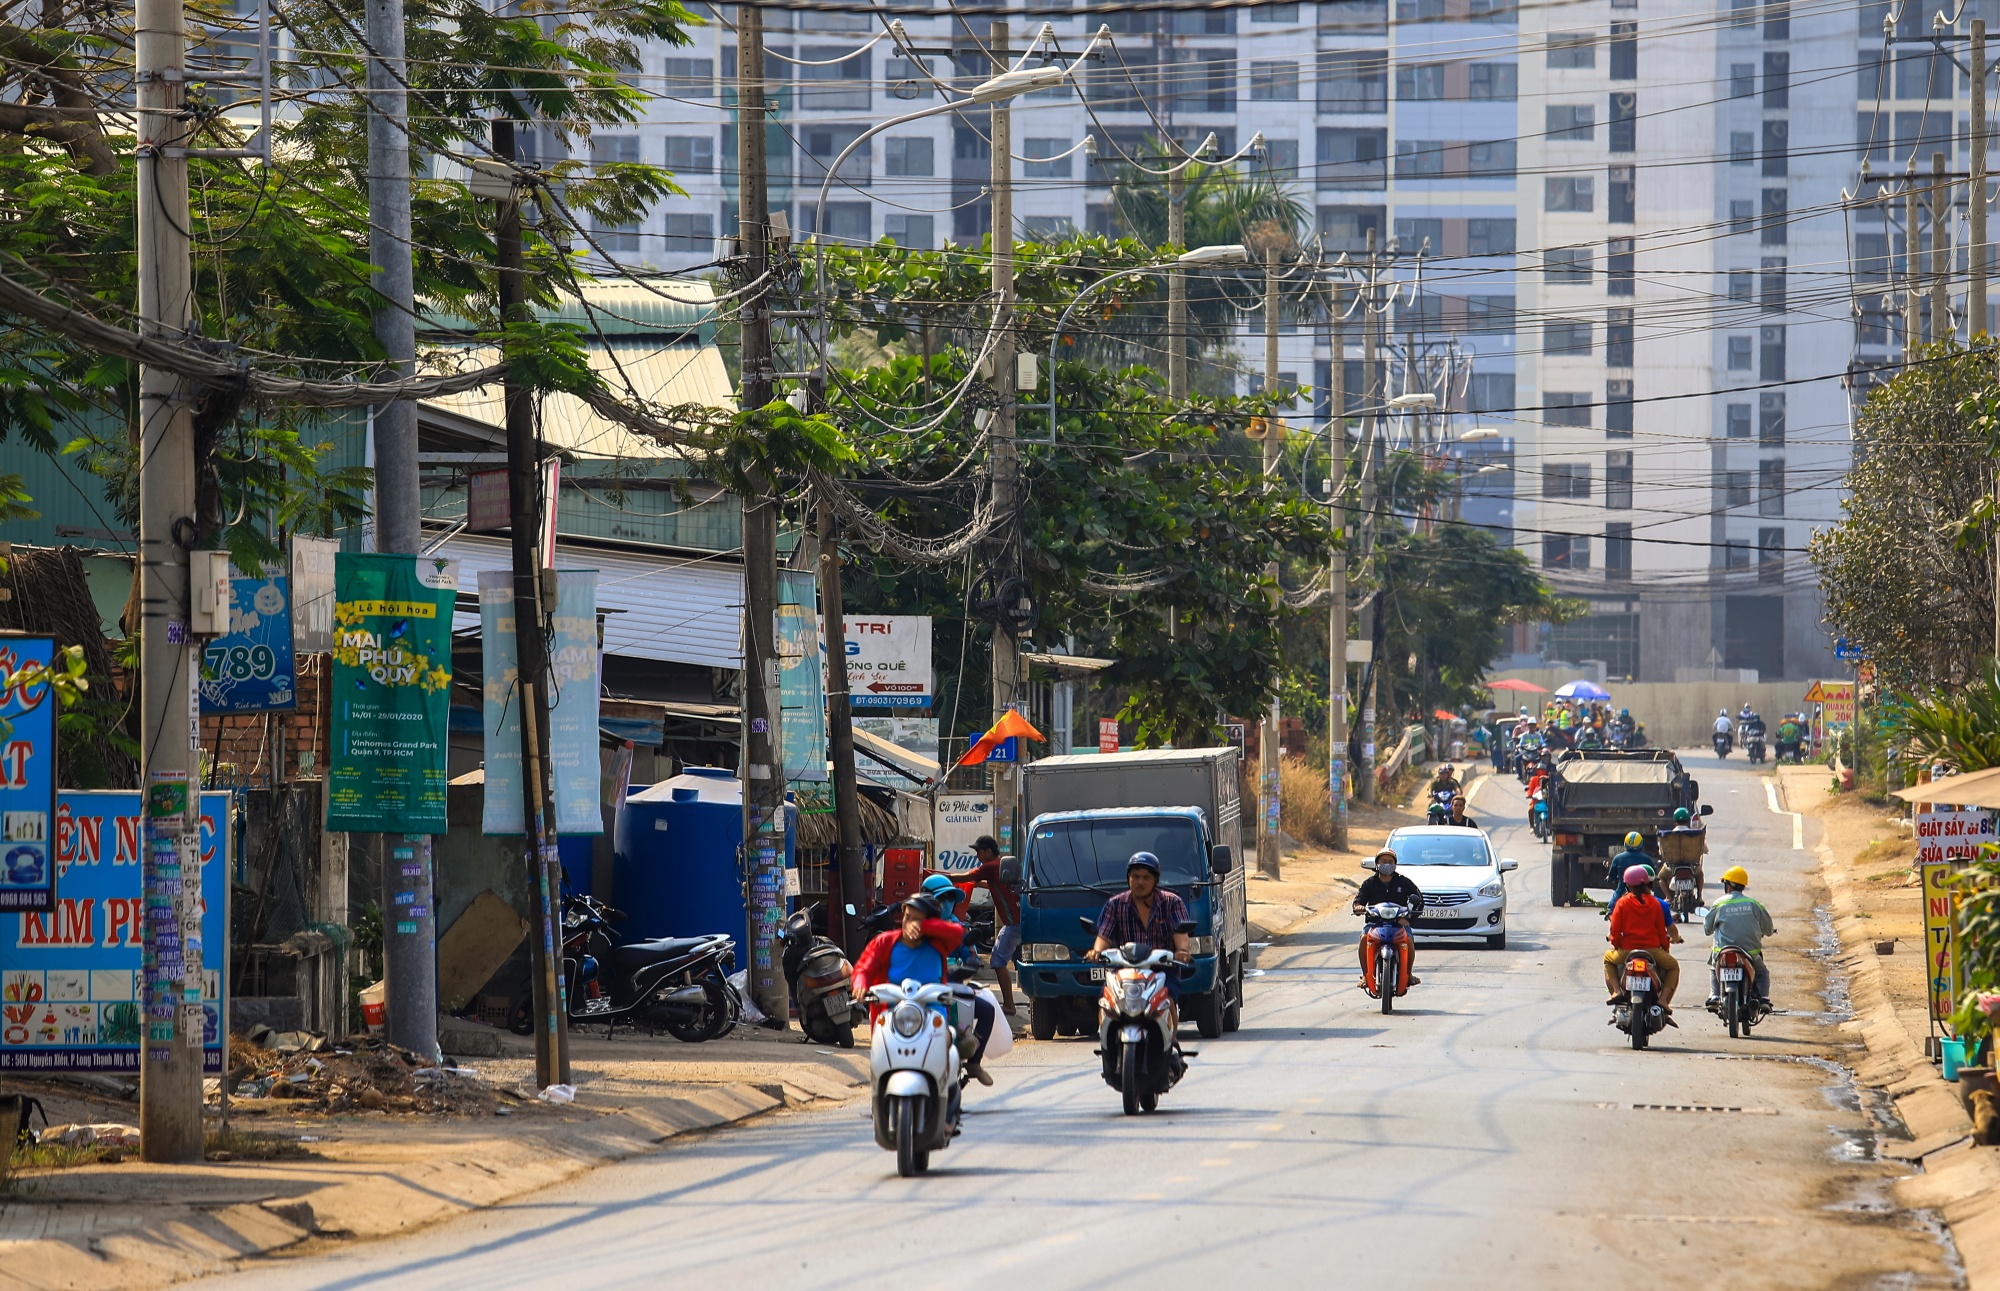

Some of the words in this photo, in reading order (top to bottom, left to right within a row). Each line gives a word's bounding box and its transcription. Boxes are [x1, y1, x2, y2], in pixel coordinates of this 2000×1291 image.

[358, 603, 373, 612] Lễ
[379, 604, 400, 614] hội
[406, 605, 428, 615] hoa
[855, 620, 894, 635] TRÍ
[342, 633, 382, 648] MAI
[359, 646, 402, 665] PHÚ
[205, 643, 275, 683] 789
[877, 660, 906, 671] QUÊ
[370, 663, 416, 685] QUÝ
[351, 711, 371, 719] 14/01
[377, 712, 423, 721] 29/01/2020
[1834, 712, 1852, 722] 20K
[351, 739, 392, 748] Vinhomes
[392, 741, 418, 749] Grand
[351, 747, 373, 758] Quận
[383, 749, 414, 757] TP.HCM
[994, 748, 1007, 759] 21
[858, 758, 873, 767] 29
[939, 800, 951, 813] Cà
[952, 800, 970, 813] Phê
[962, 815, 983, 823] KHÁT
[1920, 839, 1944, 863] SỬA
[19, 892, 33, 906] 684
[34, 892, 47, 906] 563
[21, 898, 95, 945] KIM
[14, 1053, 28, 1067] 560
[76, 1053, 92, 1068] Long
[92, 1053, 113, 1069] Thạnh
